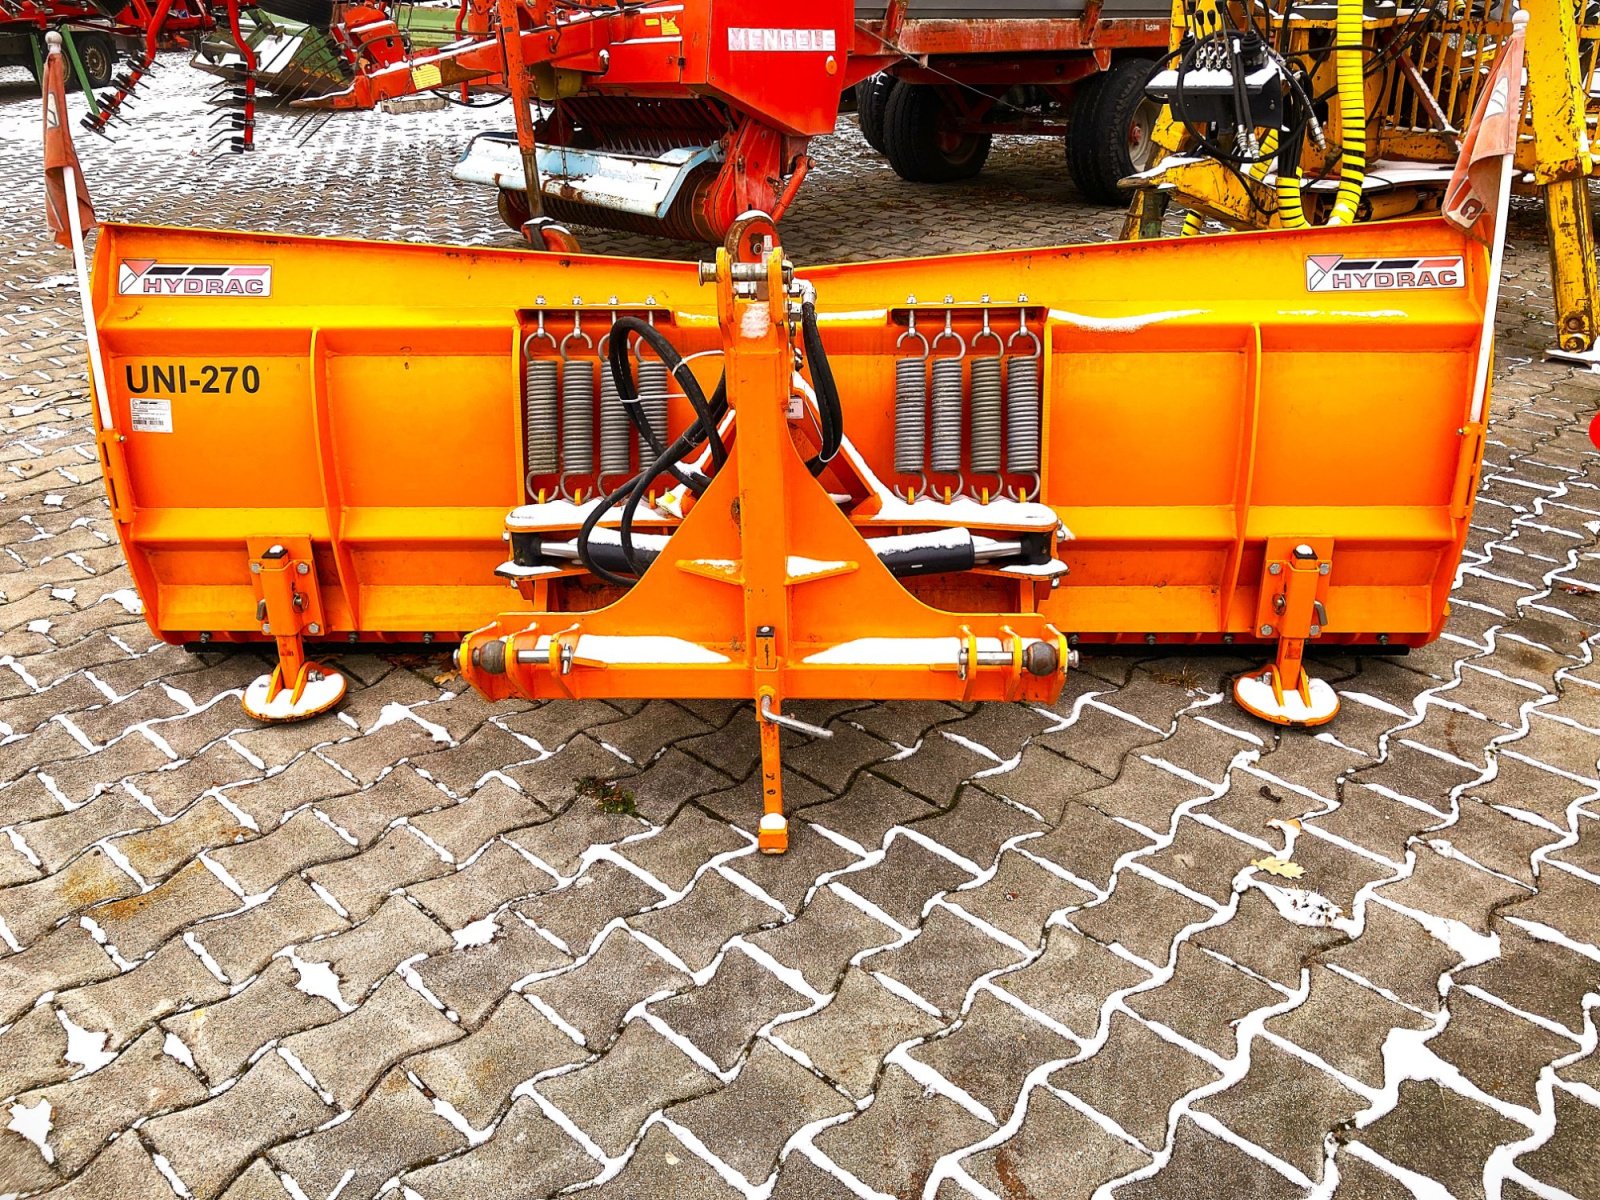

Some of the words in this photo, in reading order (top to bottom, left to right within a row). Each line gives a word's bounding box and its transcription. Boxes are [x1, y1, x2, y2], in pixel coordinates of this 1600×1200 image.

[143, 278, 263, 293] HYDRAC
[1332, 270, 1457, 288] HYDRAC
[125, 365, 260, 394] UNI-270
